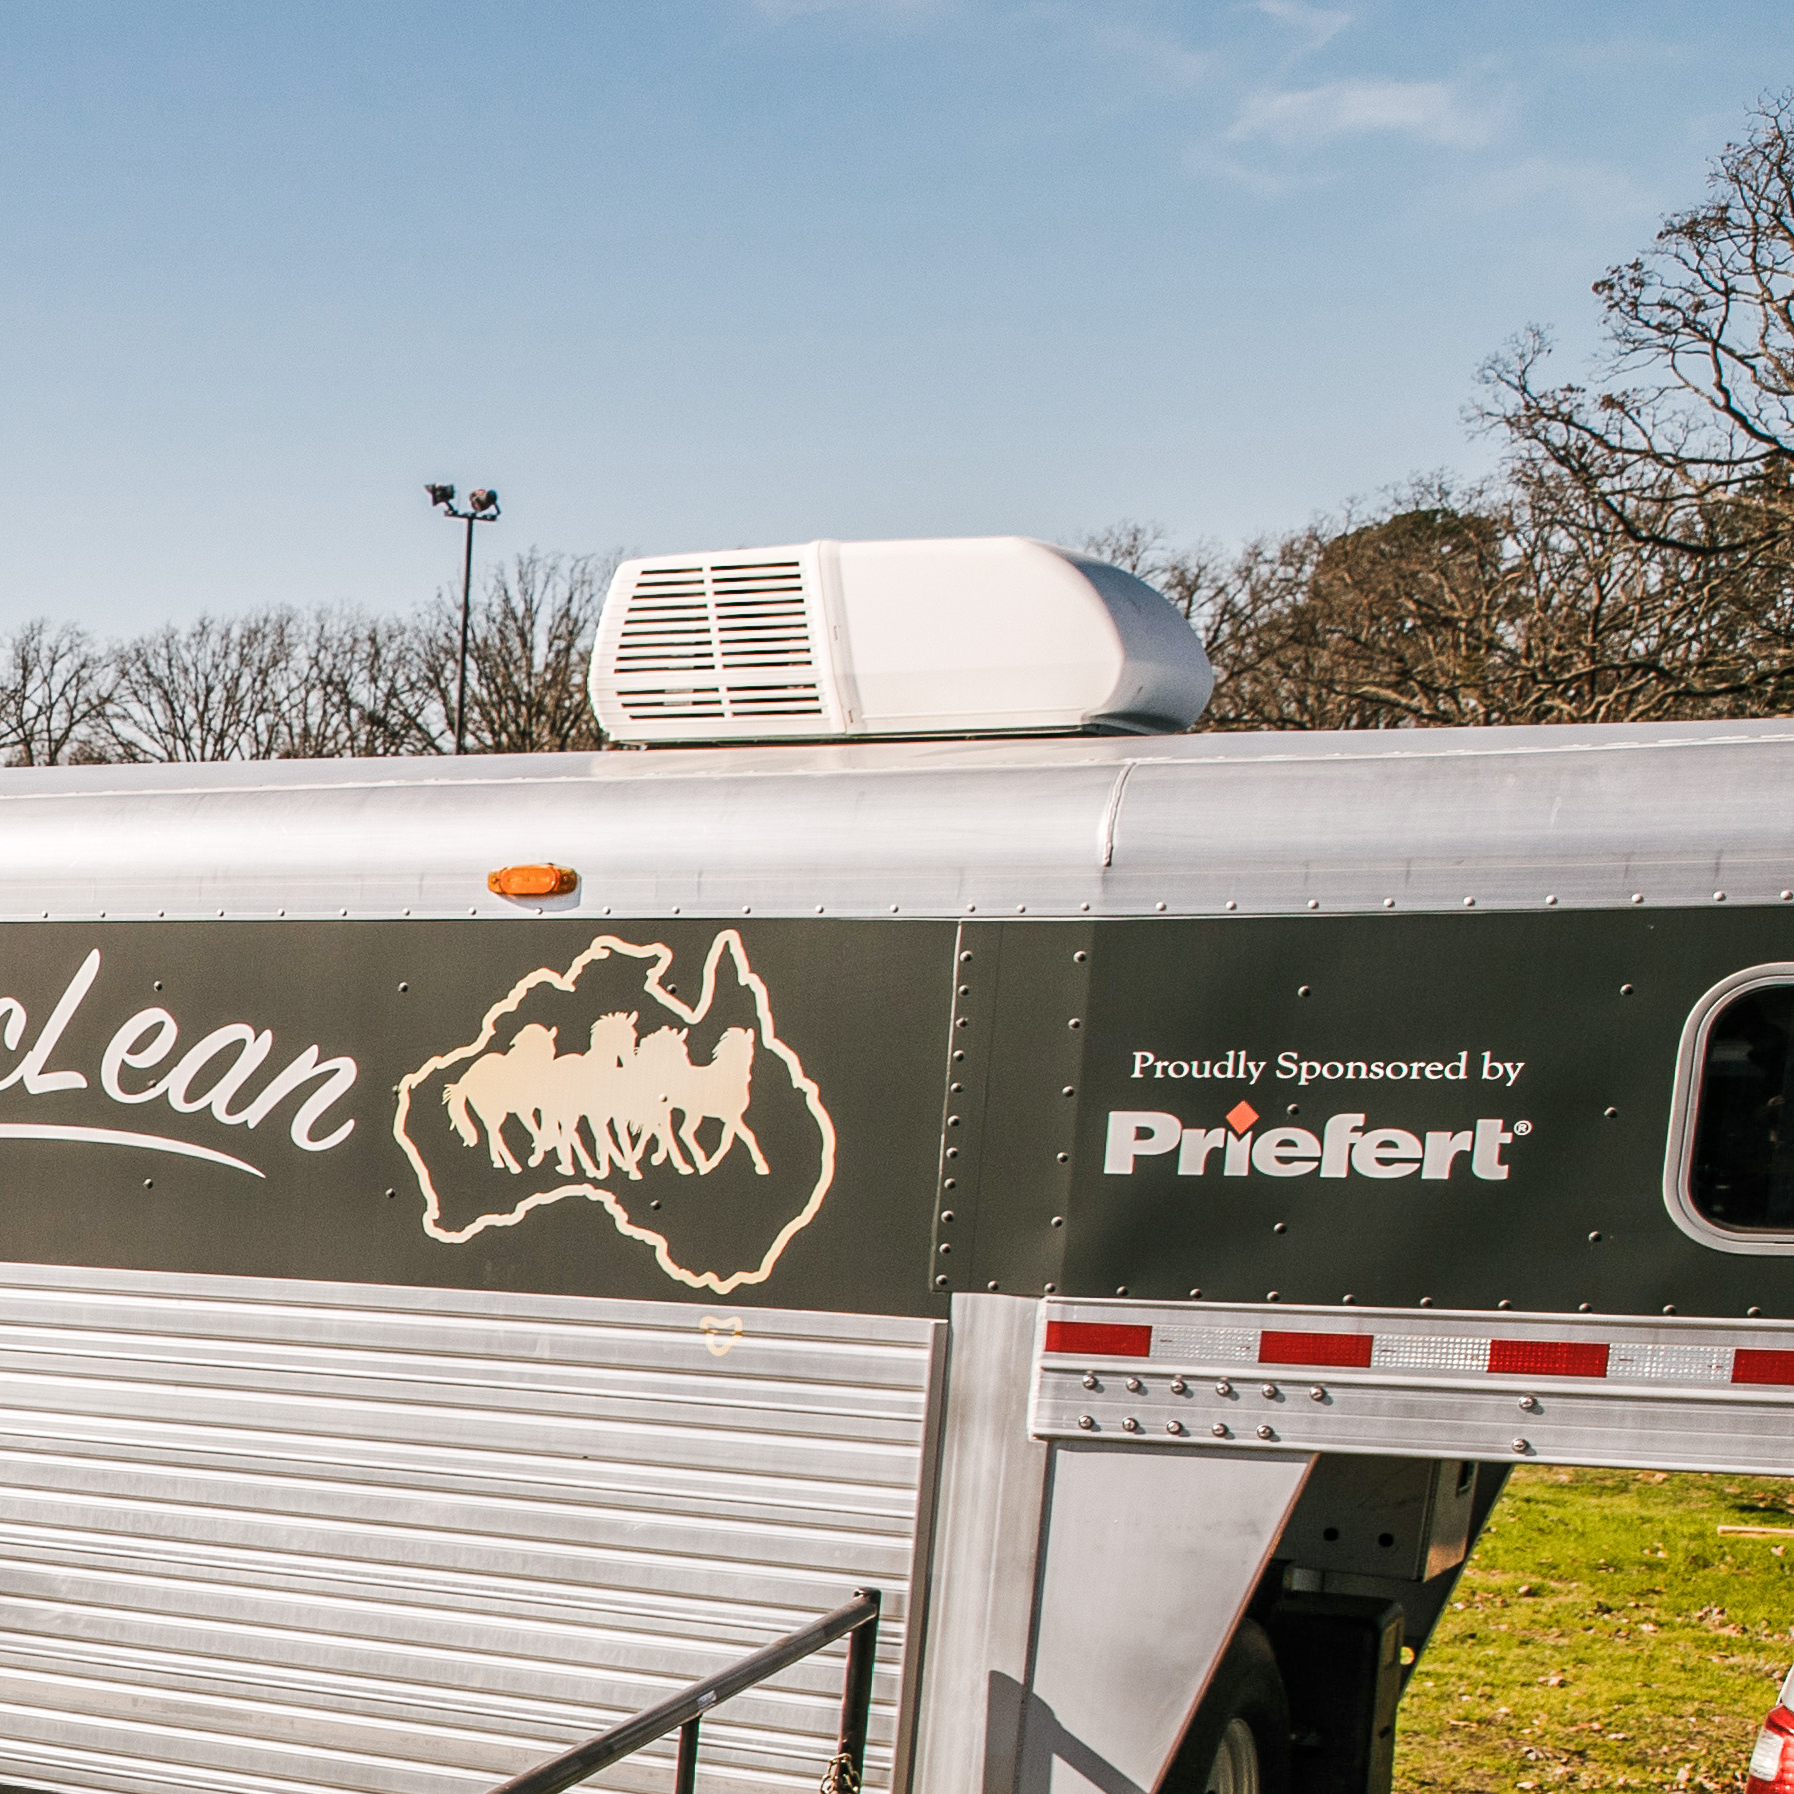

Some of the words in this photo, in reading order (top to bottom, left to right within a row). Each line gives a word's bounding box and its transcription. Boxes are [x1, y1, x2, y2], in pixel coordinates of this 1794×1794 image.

[1130, 1050, 1267, 1085] Proudly
[1275, 1050, 1468, 1086] Sponsored
[1481, 1050, 1526, 1087] by
